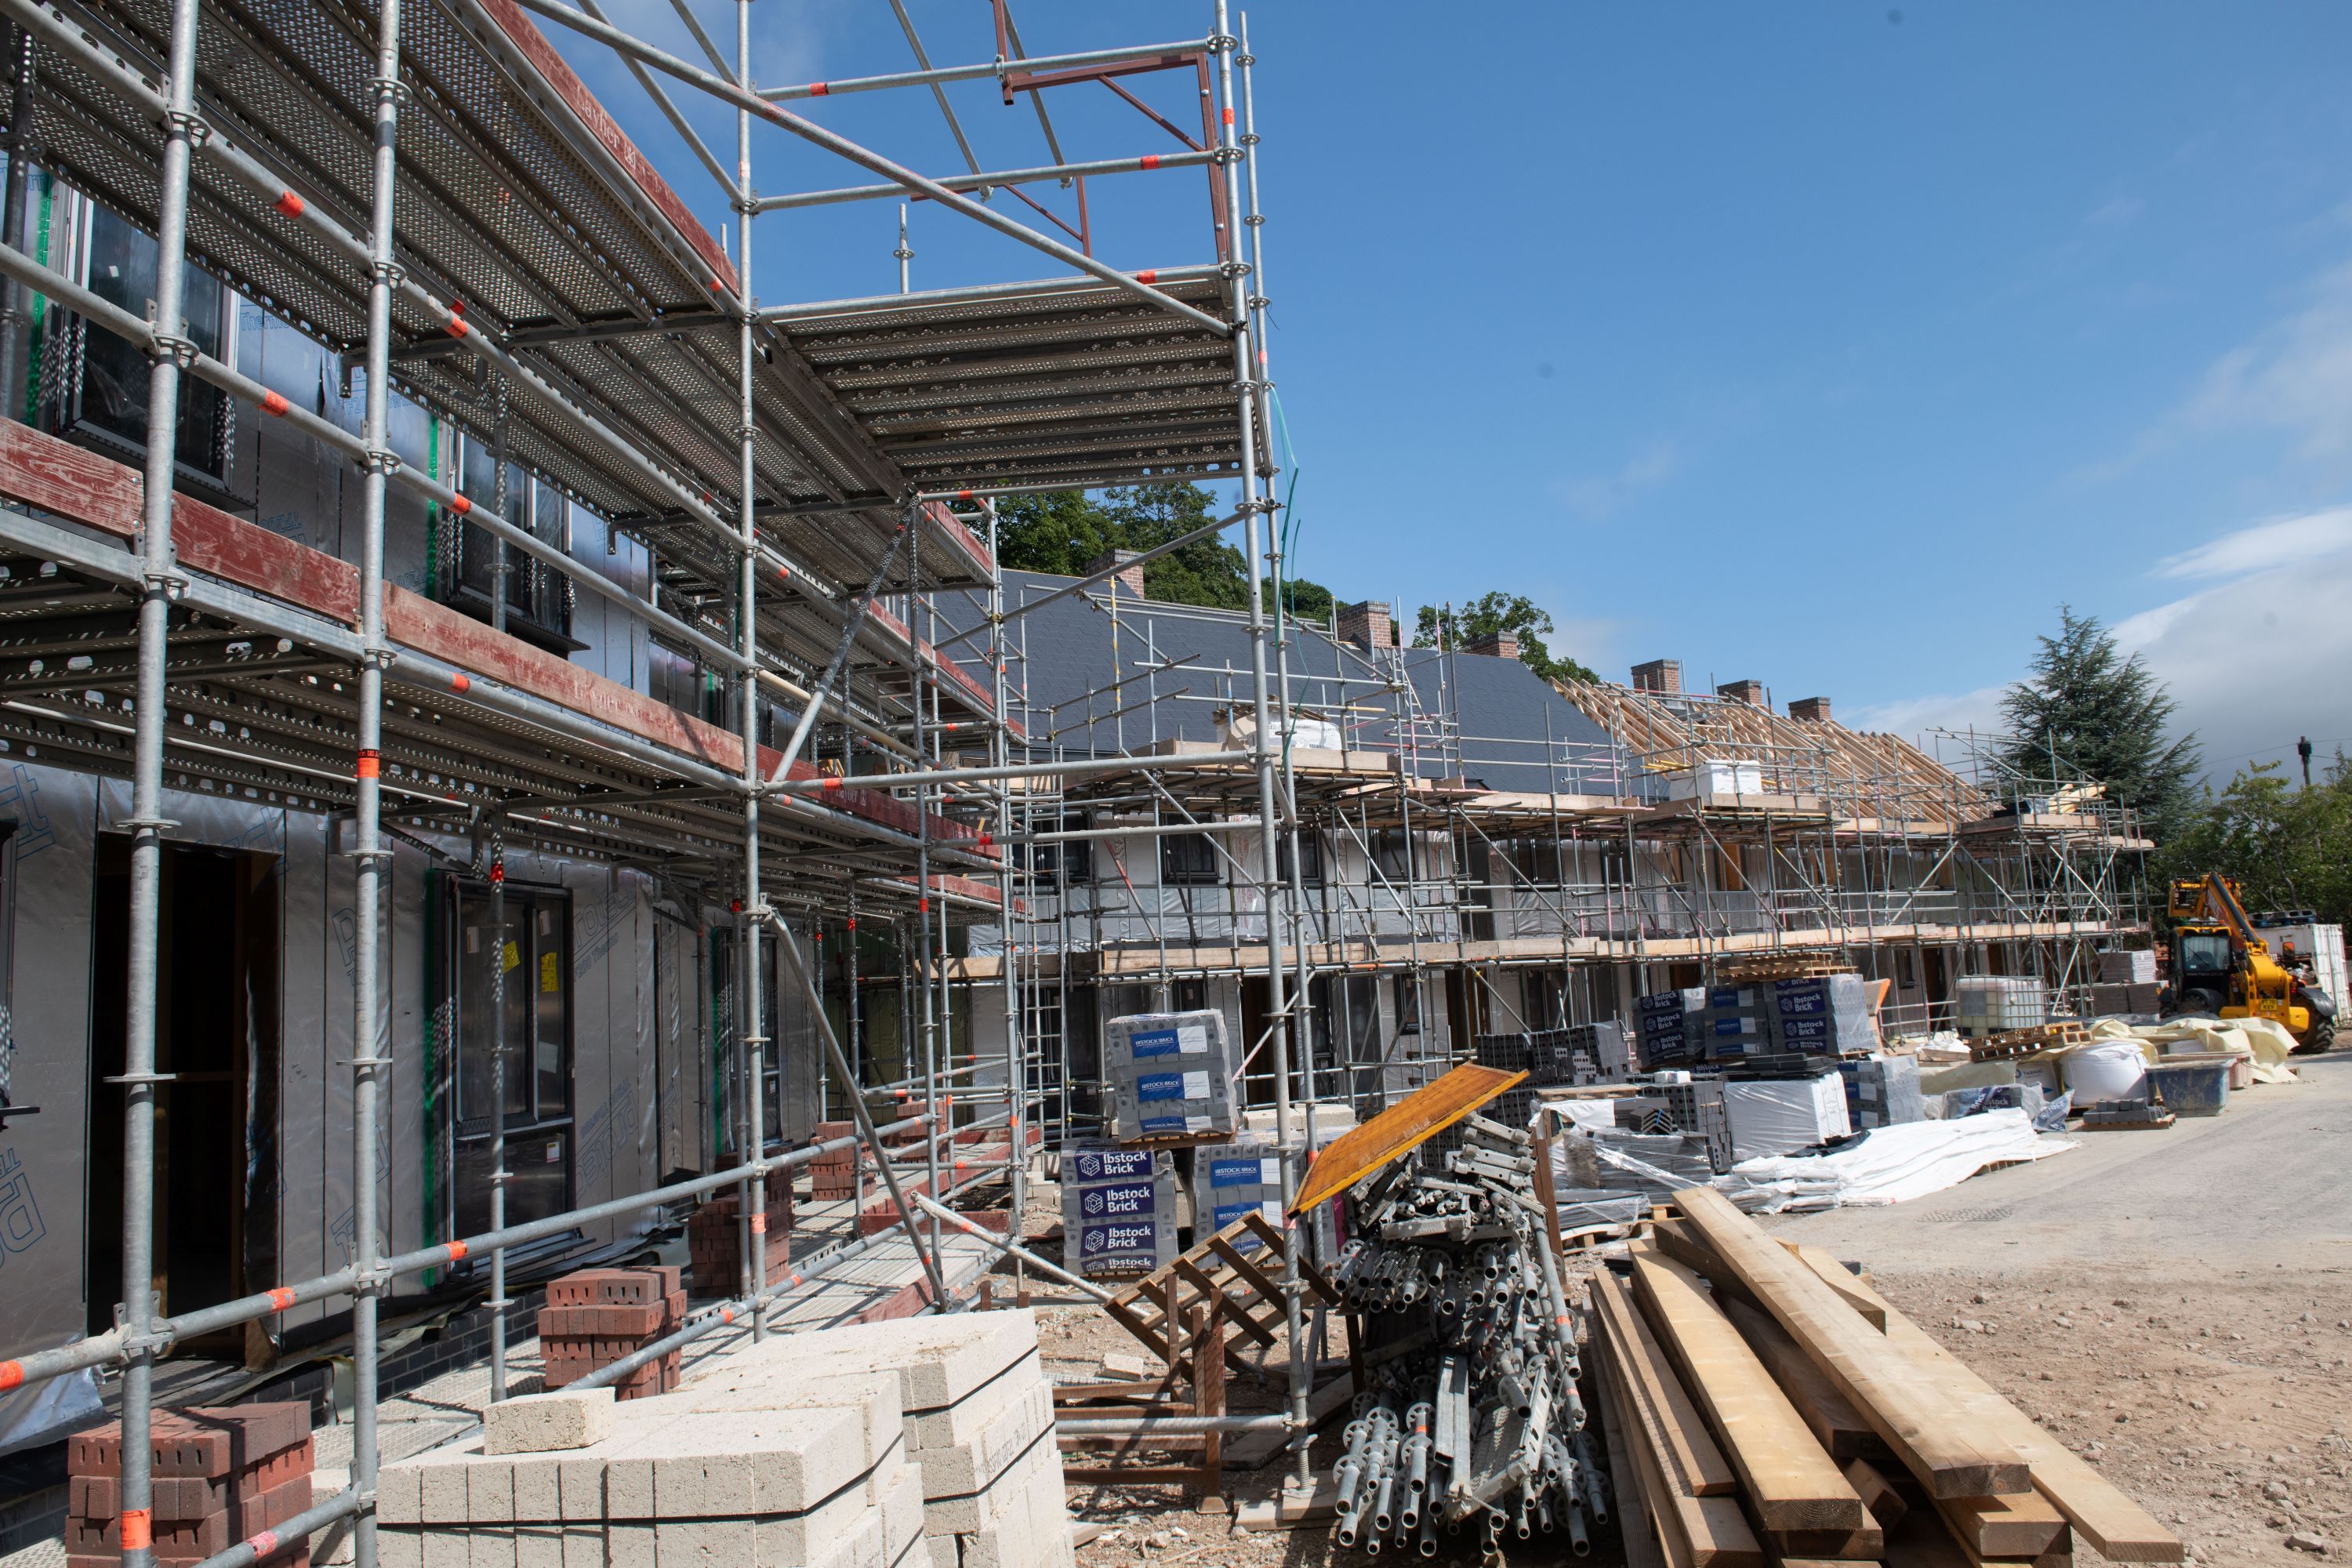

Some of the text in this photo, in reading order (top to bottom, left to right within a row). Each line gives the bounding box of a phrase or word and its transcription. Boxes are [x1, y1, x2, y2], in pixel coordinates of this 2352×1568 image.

[1653, 991, 1677, 1001] Ibstock
[1793, 993, 1820, 1004] Ibstock
[1654, 1000, 1671, 1008] Brick
[1795, 1002, 1813, 1011] Brick
[1657, 1013, 1681, 1022] Ibstock
[1657, 1021, 1673, 1029] Brick
[1798, 1020, 1824, 1029] Ibstock
[1660, 1034, 1683, 1043] Ibstock
[1661, 1041, 1677, 1050] Brick
[576, 1091, 639, 1202] Protec
[1103, 1152, 1147, 1164] Ibstock
[1105, 1163, 1134, 1174] Brick
[1107, 1187, 1150, 1201] Ibstock
[1108, 1200, 1138, 1213] Brick
[1109, 1225, 1151, 1238] Ibstock
[1108, 1237, 1137, 1249] Brick
[1109, 1258, 1152, 1266] Ibstock
